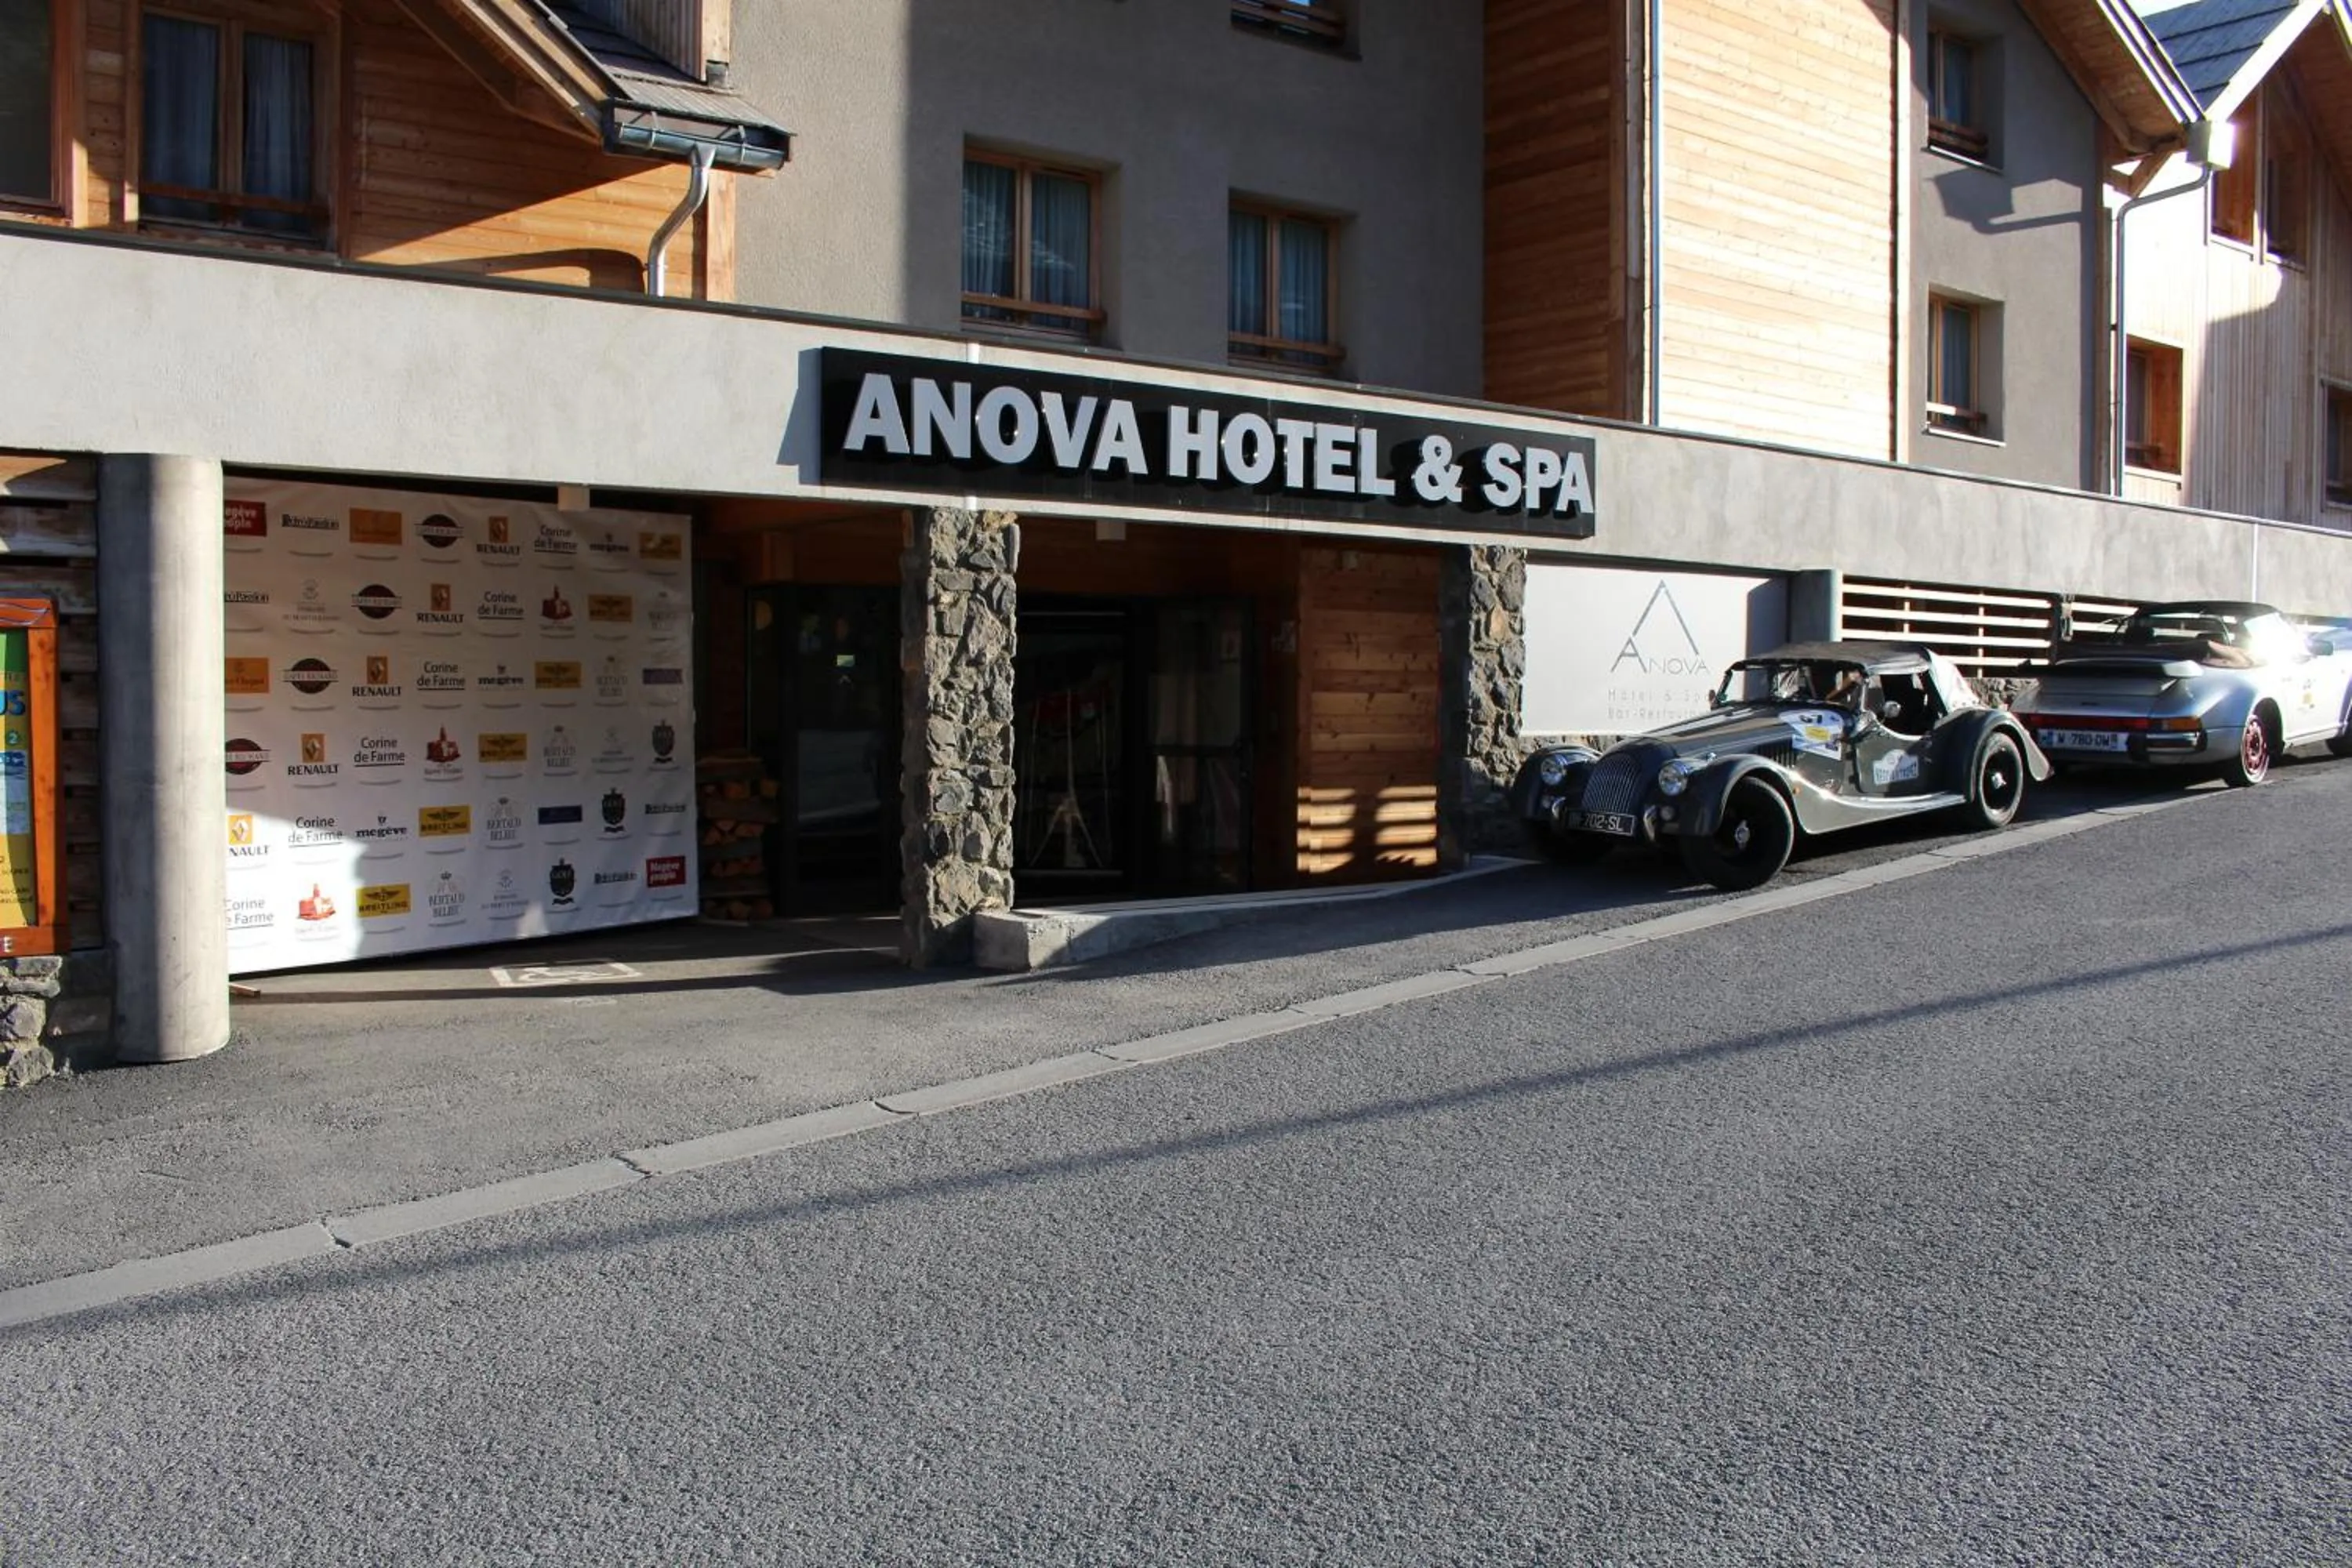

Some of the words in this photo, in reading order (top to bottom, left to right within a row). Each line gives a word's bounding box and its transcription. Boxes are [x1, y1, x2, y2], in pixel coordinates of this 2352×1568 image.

[844, 372, 1148, 474] ANOVA
[1167, 405, 1395, 495] HOTEL
[1414, 435, 1462, 503] &
[1483, 441, 1594, 514] SPA
[484, 591, 517, 603] Corine
[416, 612, 464, 624] RENAULT
[1610, 637, 1711, 674] ANOVA
[424, 661, 459, 674] Corine
[417, 675, 430, 686] de
[433, 676, 465, 688] Farme
[352, 686, 401, 697] RENAULT
[361, 737, 397, 750] Corine
[354, 753, 368, 764] de
[372, 751, 405, 763] Farme
[288, 764, 339, 776] RENAULT
[296, 816, 335, 829] Corine
[289, 833, 303, 844] de
[307, 830, 343, 842] Farme
[229, 844, 269, 857] NAULT
[234, 913, 274, 925] Farme
